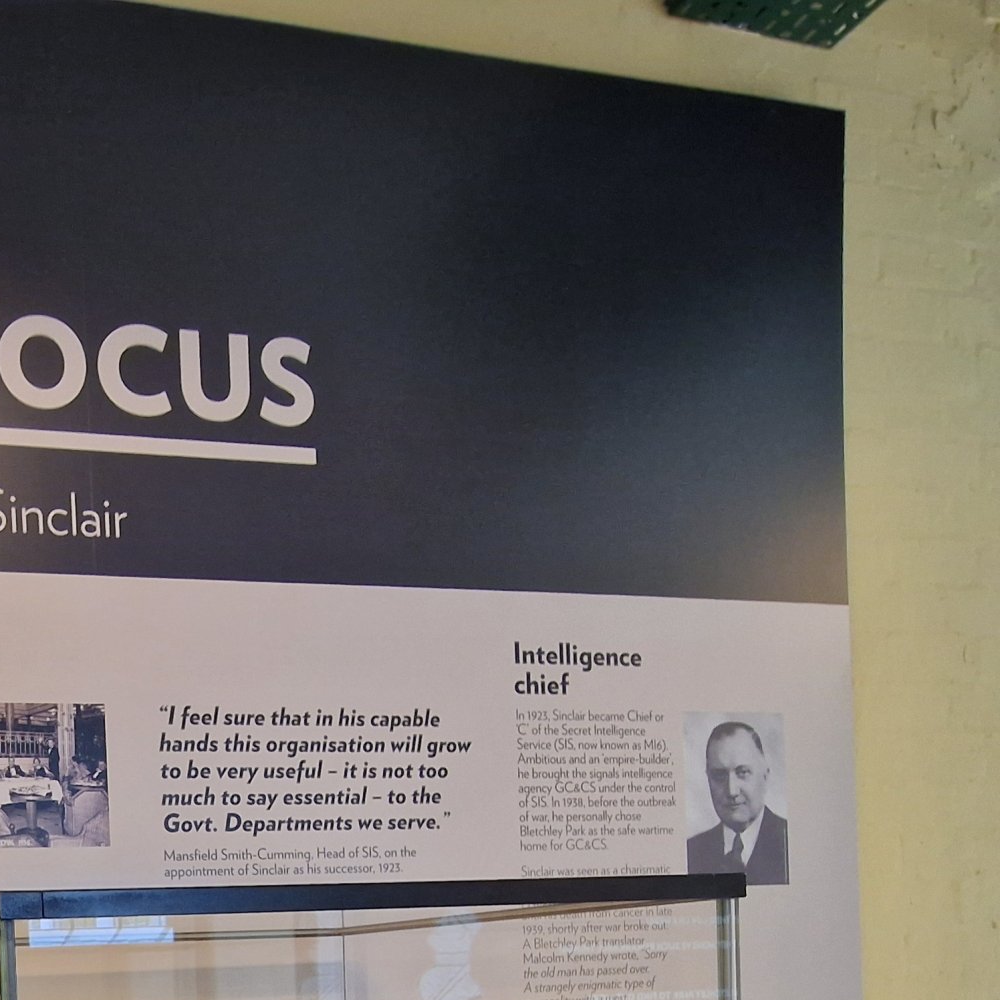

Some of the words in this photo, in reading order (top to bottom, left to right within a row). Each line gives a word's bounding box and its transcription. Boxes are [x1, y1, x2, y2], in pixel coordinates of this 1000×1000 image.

[514, 641, 642, 672] Intelligence
[514, 672, 569, 695] chief
[181, 705, 219, 730] feel
[223, 714, 265, 726] sure
[271, 707, 311, 726] that
[316, 709, 333, 726] in
[338, 708, 365, 726] his
[370, 708, 440, 732] capable
[516, 708, 525, 720] In
[527, 711, 550, 722] 1923,
[552, 708, 586, 721] Sinclair
[588, 709, 625, 722] became
[627, 709, 653, 722] Chief
[159, 732, 218, 752] hands
[224, 733, 260, 752] this
[266, 735, 385, 758] organisation
[391, 734, 423, 753] will
[427, 742, 471, 758] grow
[161, 764, 181, 779] to
[187, 759, 211, 779] be
[217, 767, 259, 784] very
[264, 760, 323, 784] useful
[343, 761, 357, 779] it
[362, 762, 377, 779] is
[382, 764, 413, 779] not
[419, 764, 448, 778] too
[162, 786, 215, 806] much
[221, 791, 241, 805] to
[246, 794, 278, 810] say
[283, 786, 367, 805] essential
[388, 790, 406, 804] to
[412, 786, 441, 804] the
[164, 813, 217, 833] Govt.
[225, 813, 352, 837] Departments
[358, 819, 383, 830] we
[164, 848, 218, 861] Mansfield
[221, 847, 314, 862] Smith-Cumming,
[317, 847, 345, 859] Head
[348, 846, 359, 858] of
[362, 846, 381, 858] SIS,
[400, 846, 416, 857] the
[164, 866, 234, 880] appointment
[238, 863, 249, 876] of
[252, 863, 290, 876] Sinclair
[293, 866, 304, 875] as
[306, 862, 321, 874] his
[324, 865, 376, 874] successor,
[379, 863, 403, 873] 1923.
